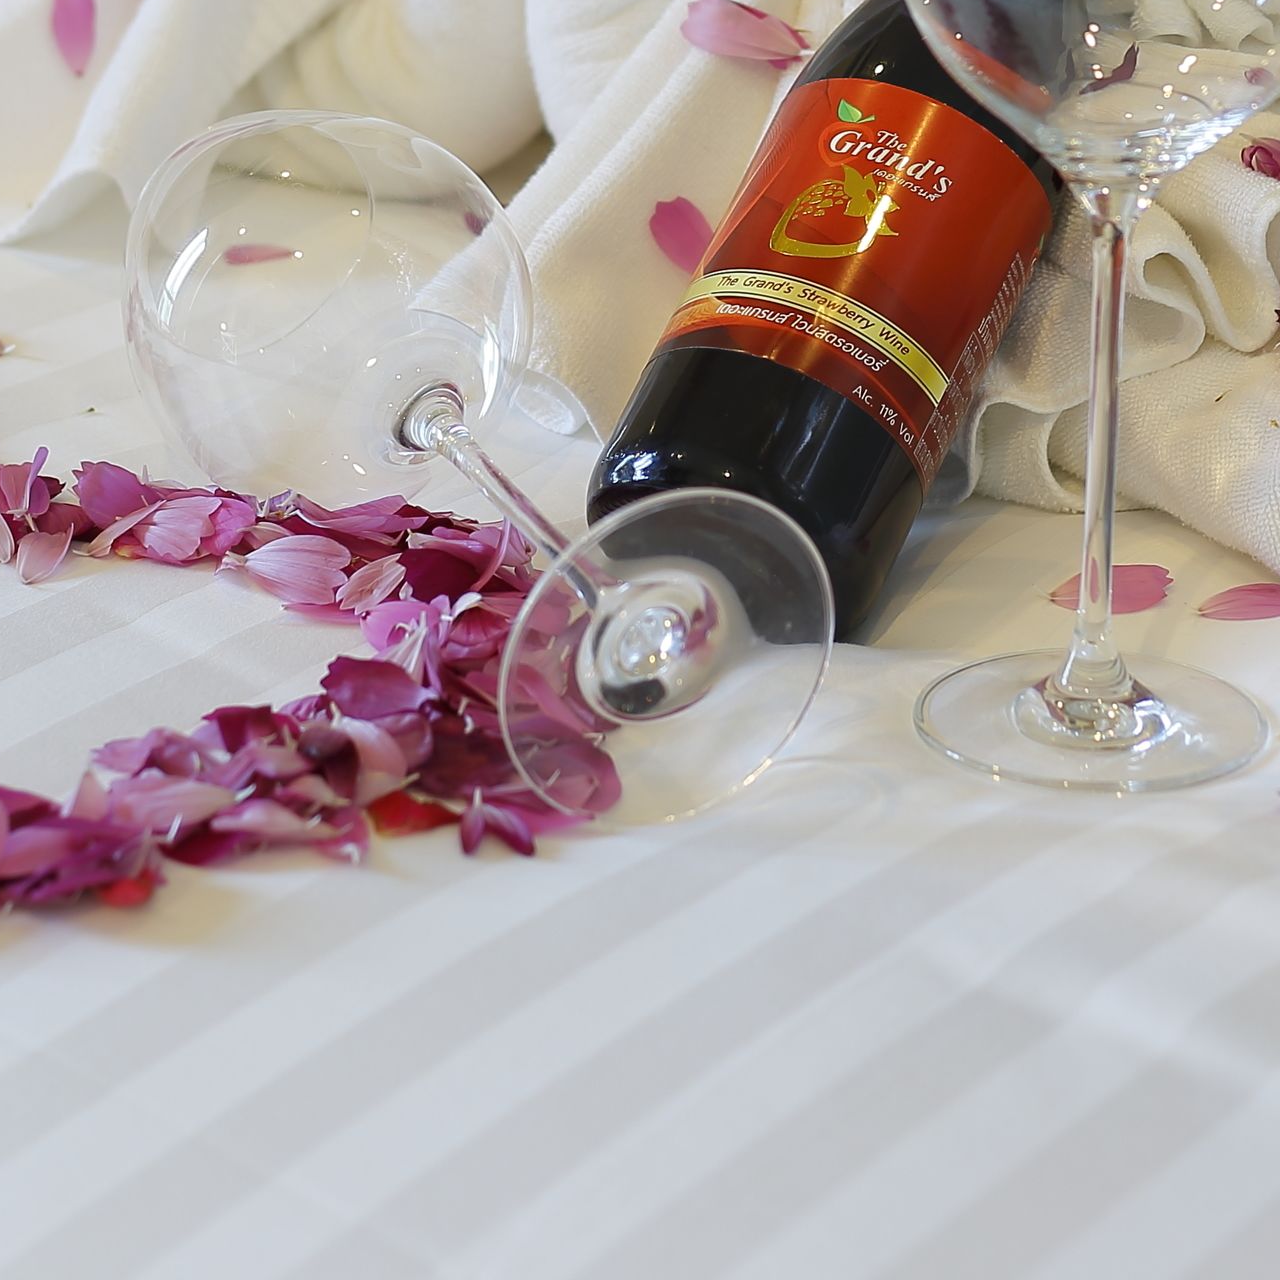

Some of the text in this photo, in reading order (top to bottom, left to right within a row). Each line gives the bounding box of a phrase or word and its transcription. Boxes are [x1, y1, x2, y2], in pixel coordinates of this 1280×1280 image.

[829, 130, 953, 194] Grand's
[877, 130, 908, 151] The
[717, 275, 910, 356] The Grand's Strawberry Wine
[852, 385, 873, 408] Alc.
[879, 404, 899, 426] 11%
